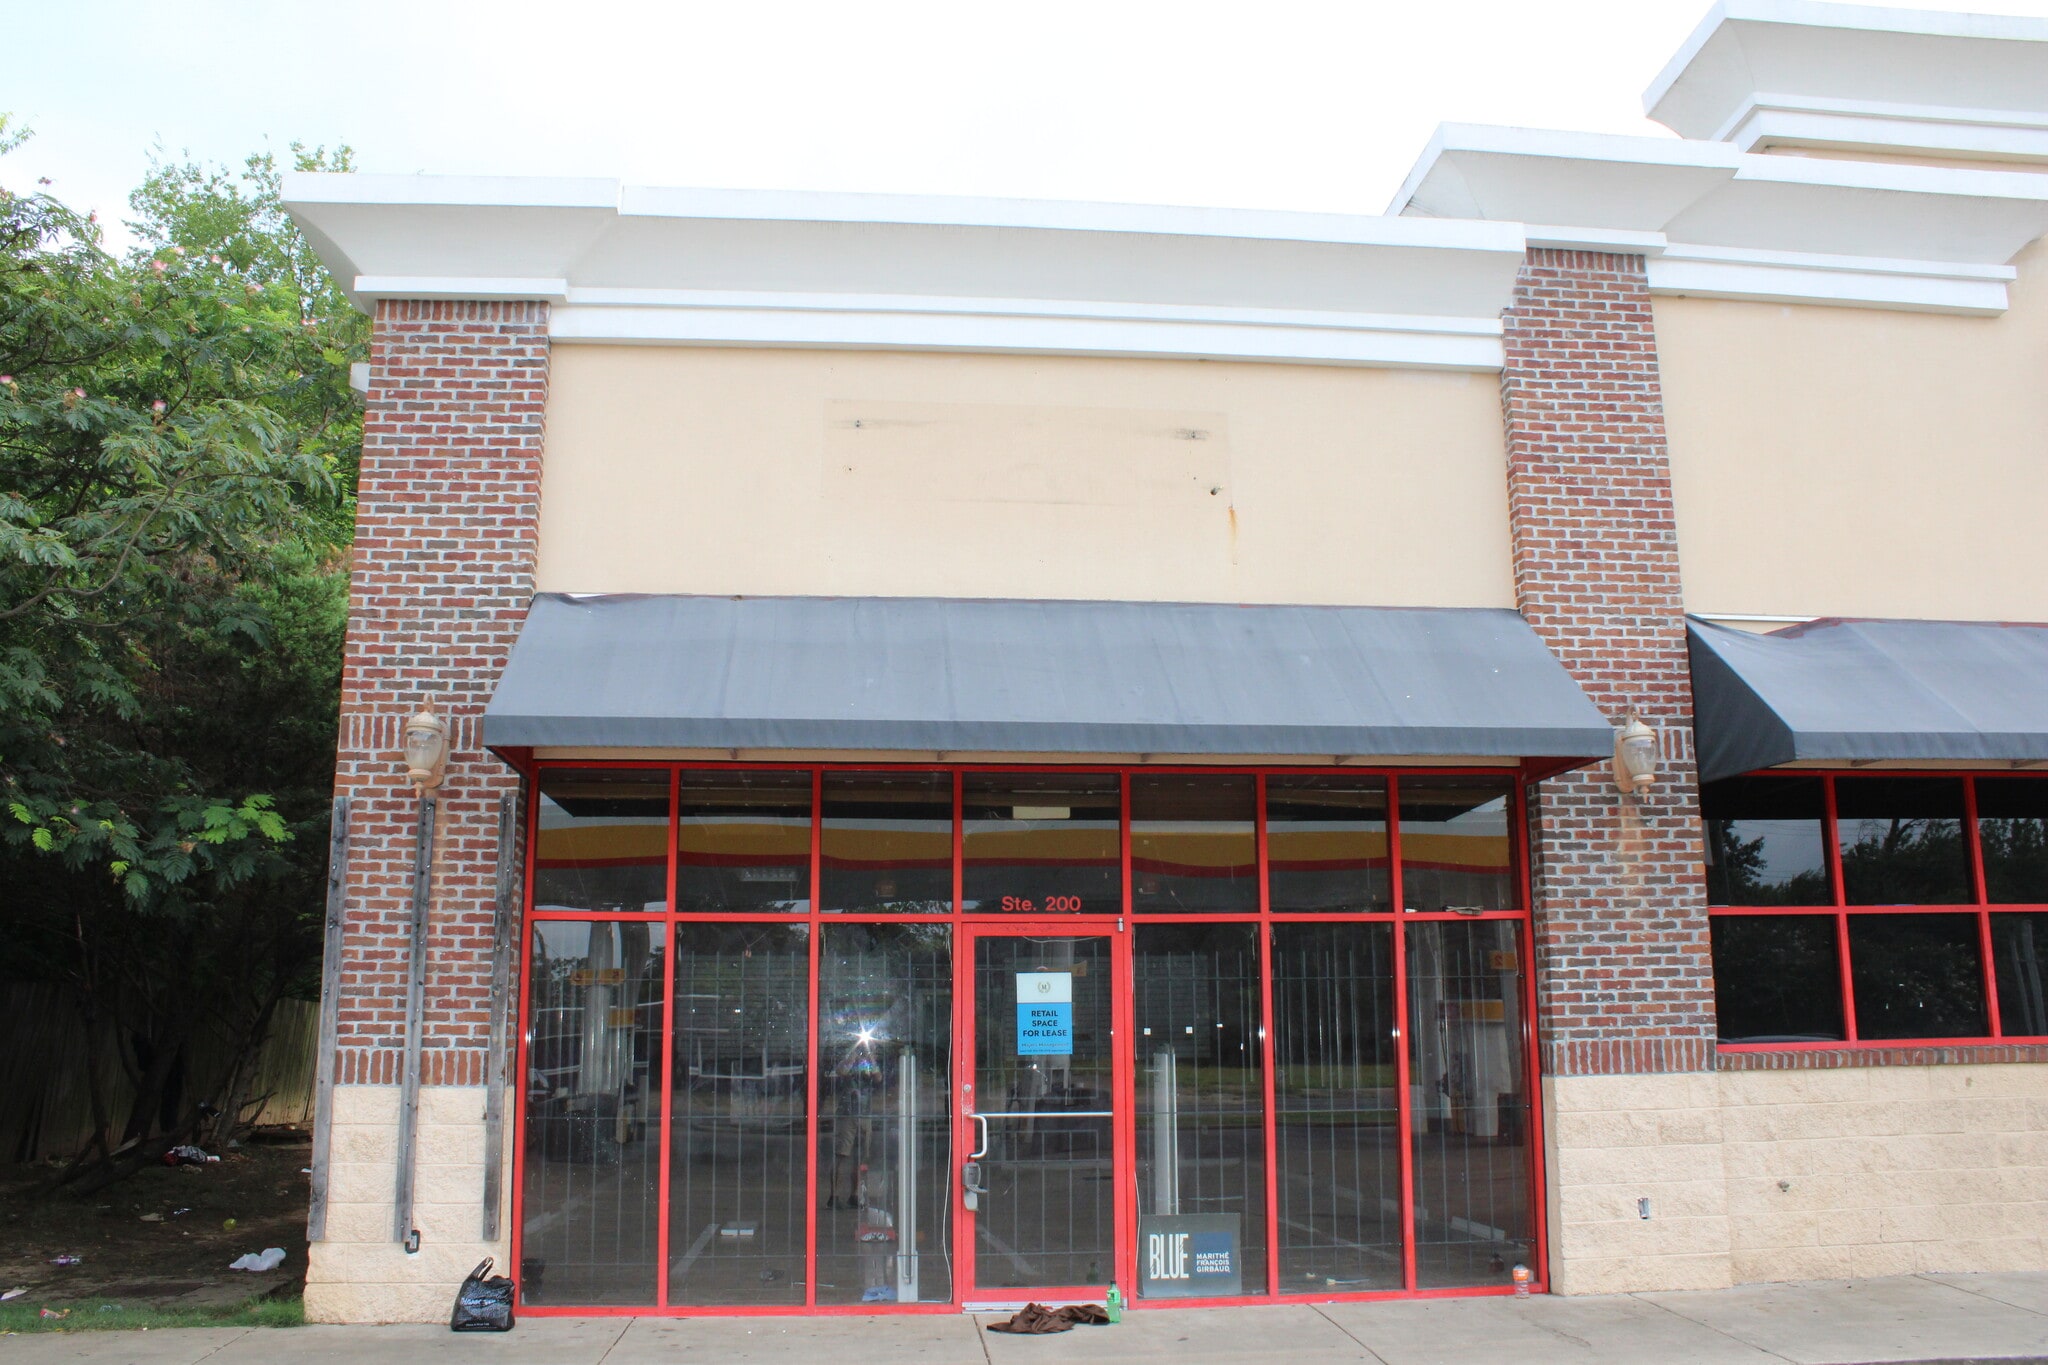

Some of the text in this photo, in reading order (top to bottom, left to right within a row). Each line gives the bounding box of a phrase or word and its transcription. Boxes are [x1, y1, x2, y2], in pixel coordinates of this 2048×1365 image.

[1001, 895, 1081, 911] Ste. 200
[1149, 1233, 1189, 1280] BLUE
